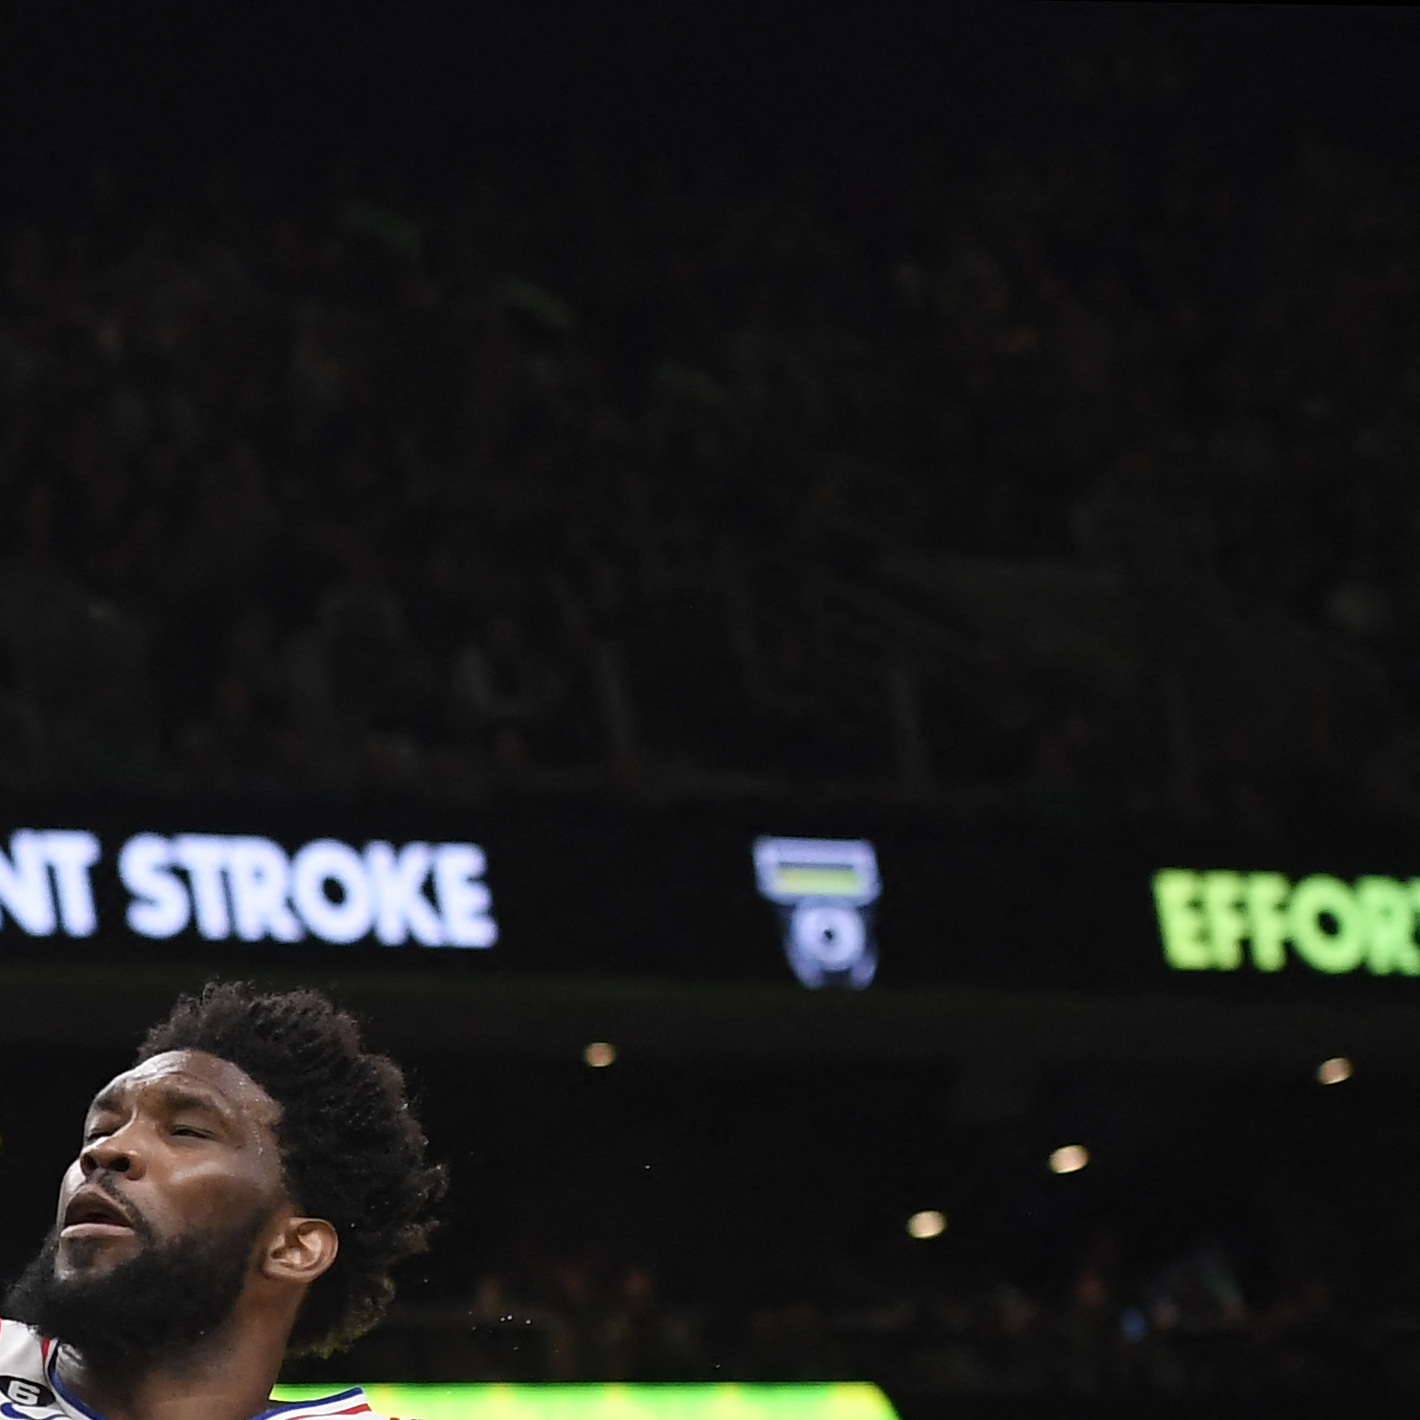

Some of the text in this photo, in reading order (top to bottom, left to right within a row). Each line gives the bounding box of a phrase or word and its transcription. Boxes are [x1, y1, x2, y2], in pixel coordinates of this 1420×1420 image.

[117, 830, 501, 950] STROKE
[1151, 867, 1420, 977] EFFOR
[7, 1380, 41, 1406] 6
